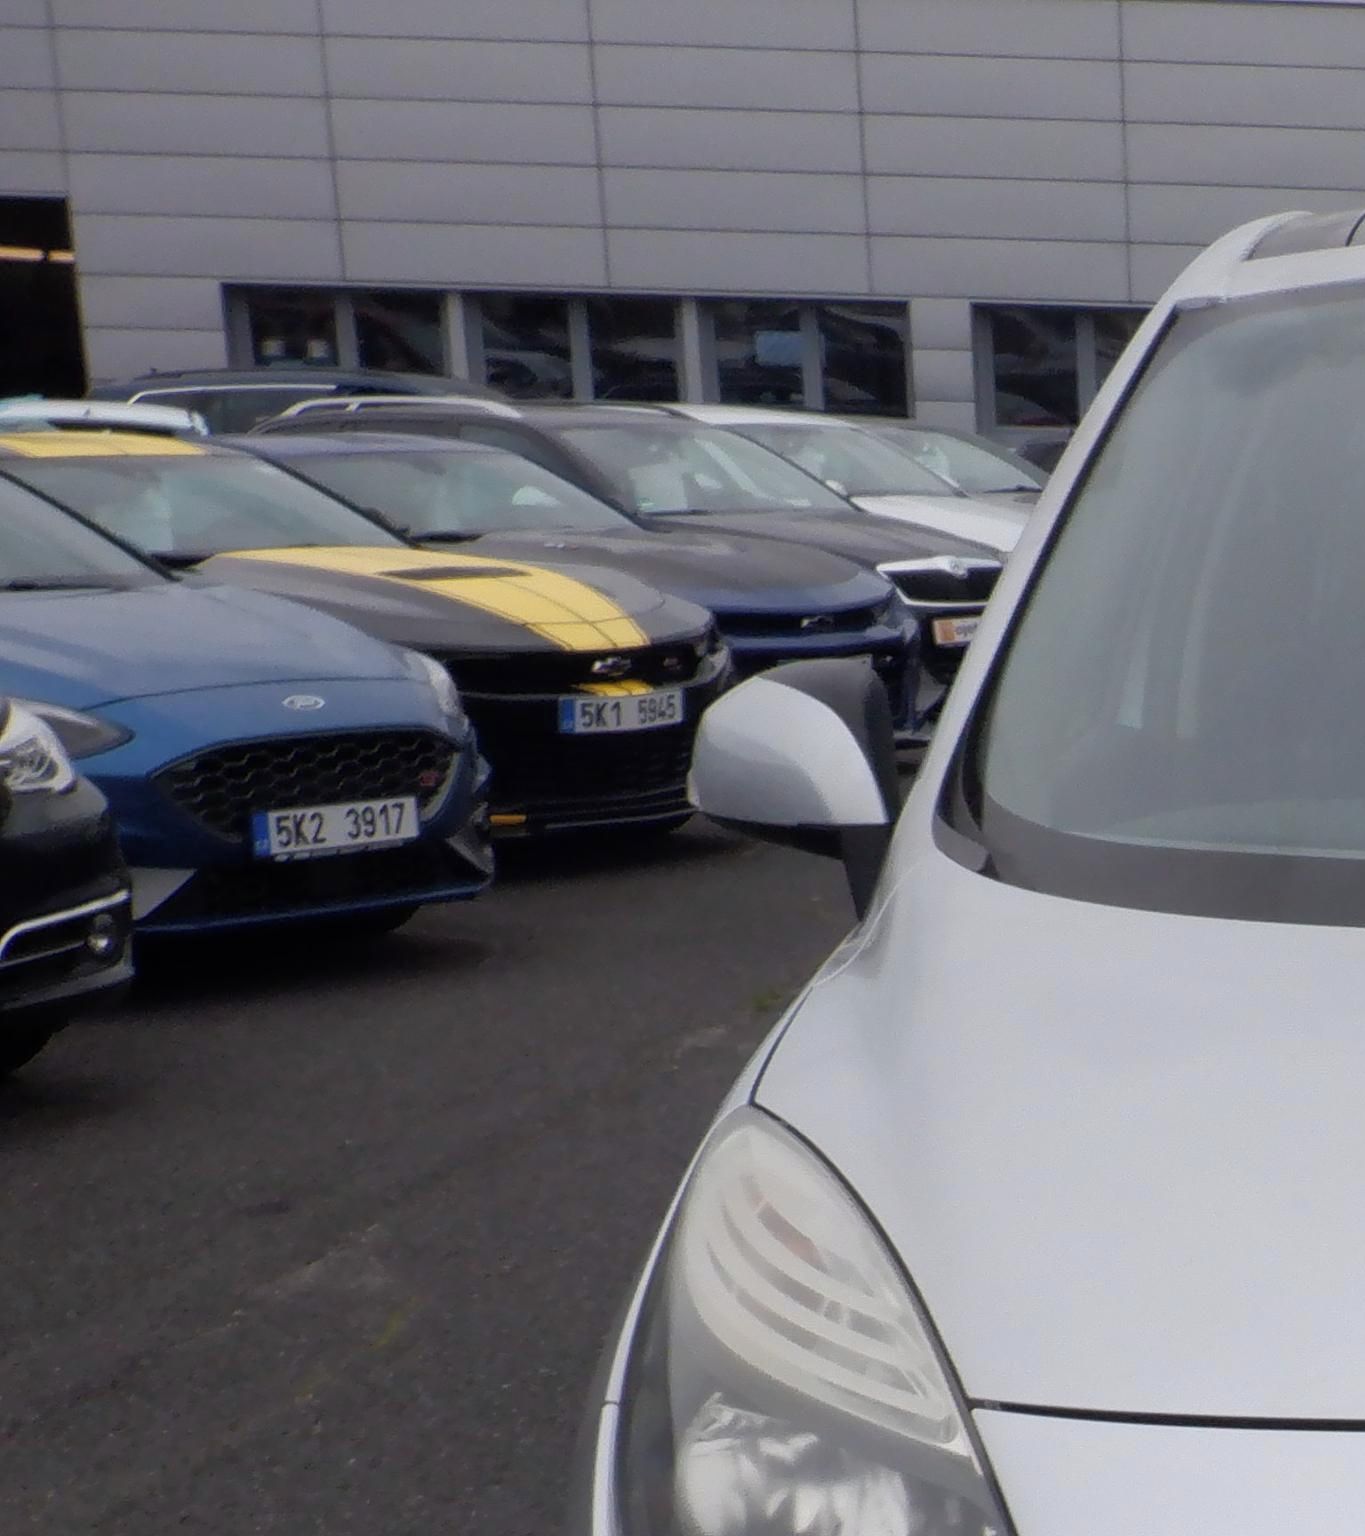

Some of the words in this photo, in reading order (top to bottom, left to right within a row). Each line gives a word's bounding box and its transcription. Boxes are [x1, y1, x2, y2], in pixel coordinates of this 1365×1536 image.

[579, 700, 623, 728] 5K1
[275, 811, 327, 848] 5K2
[344, 802, 406, 840] 3917
